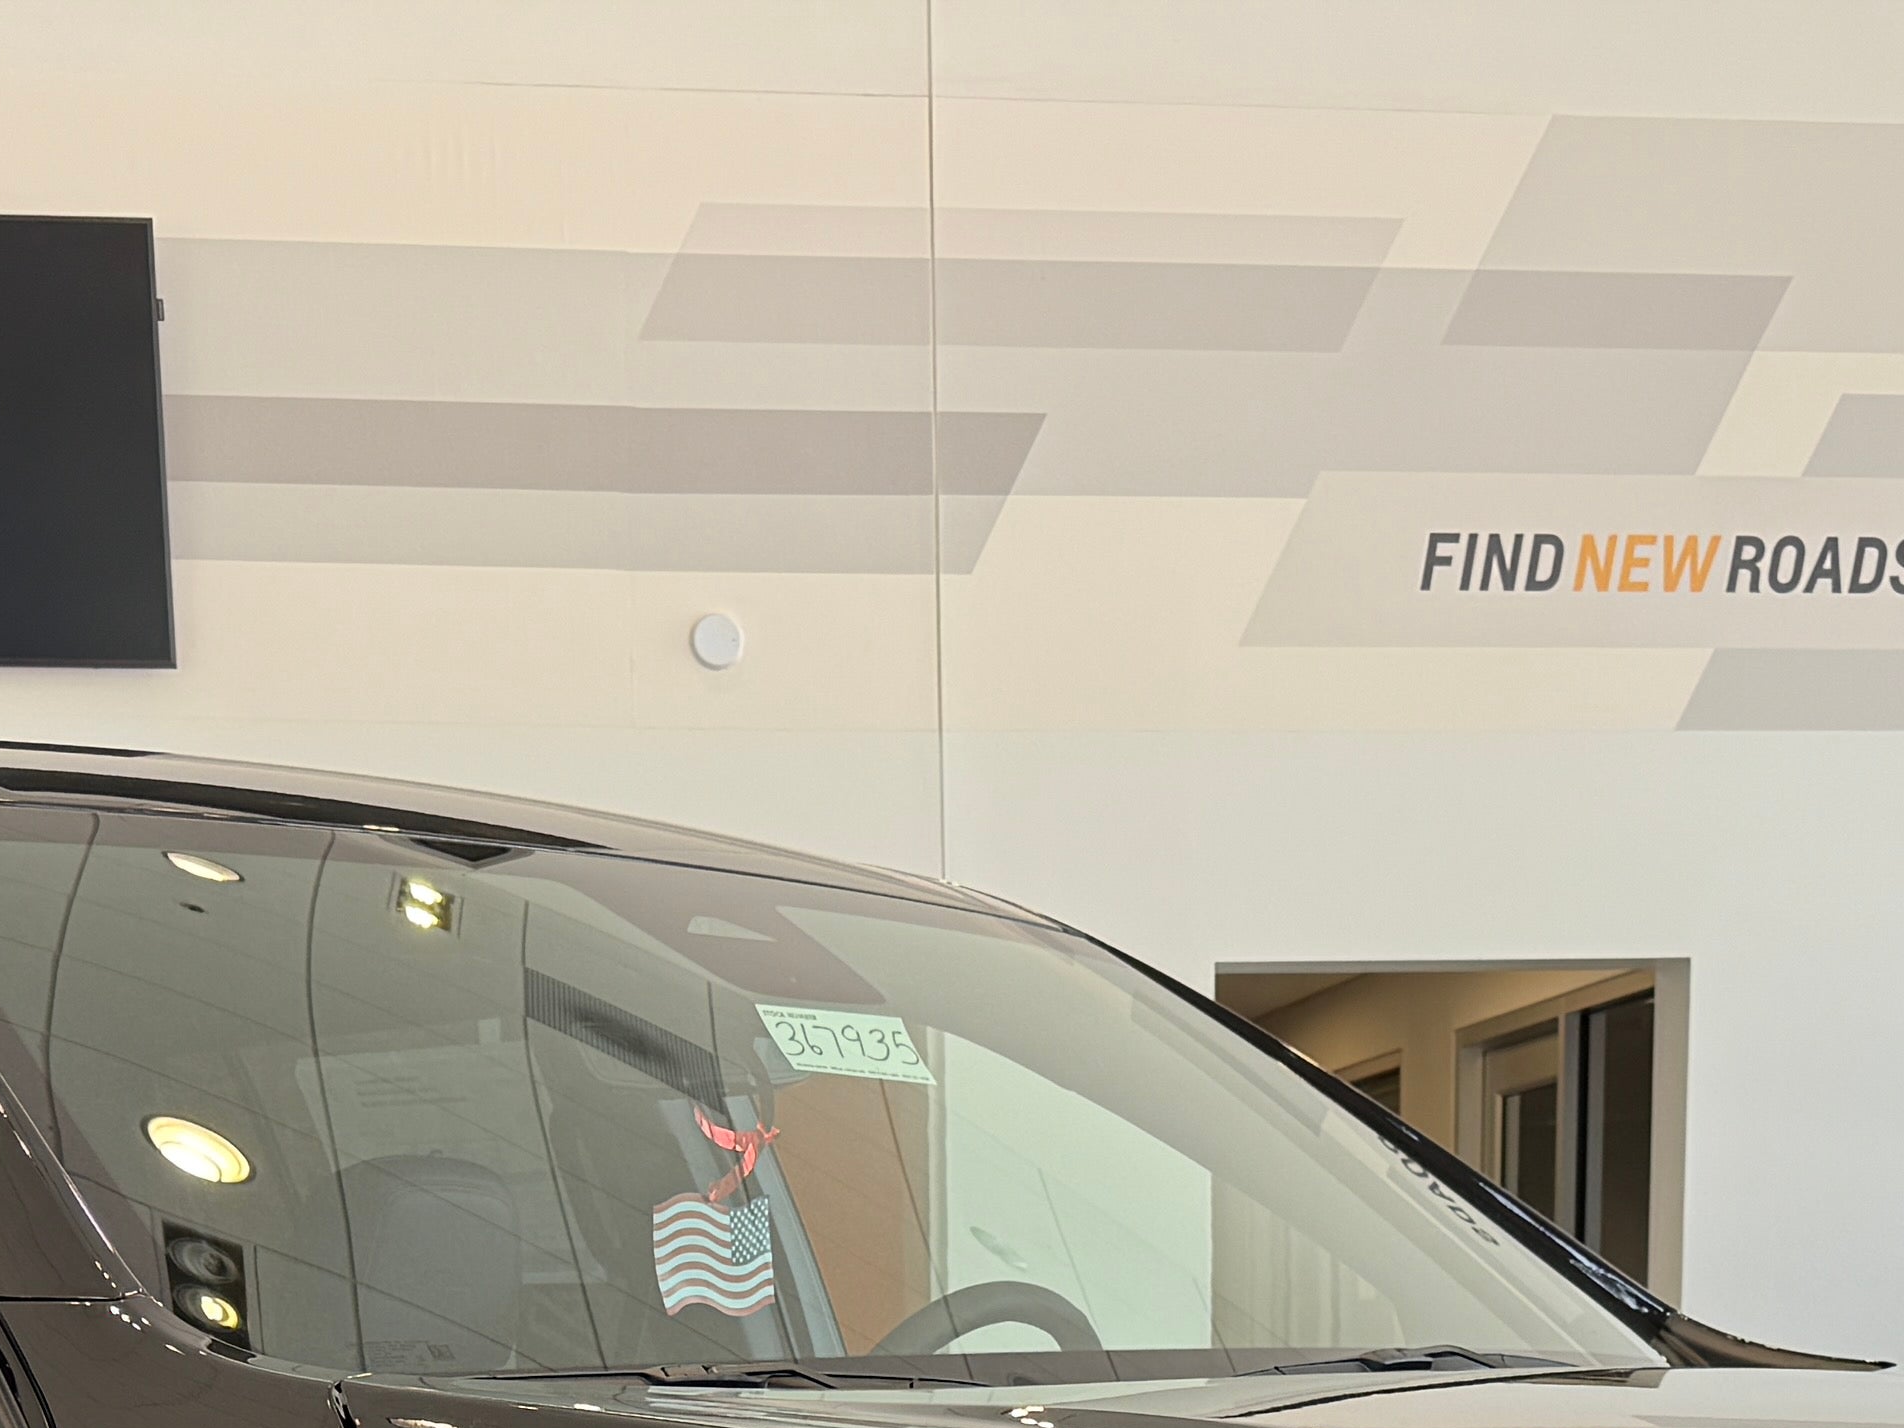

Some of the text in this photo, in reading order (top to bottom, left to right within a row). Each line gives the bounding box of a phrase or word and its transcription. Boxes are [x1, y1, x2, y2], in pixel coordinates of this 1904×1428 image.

[1419, 531, 1564, 592] FIND
[1572, 533, 1721, 593] NEW
[774, 1020, 921, 1066] 367935
